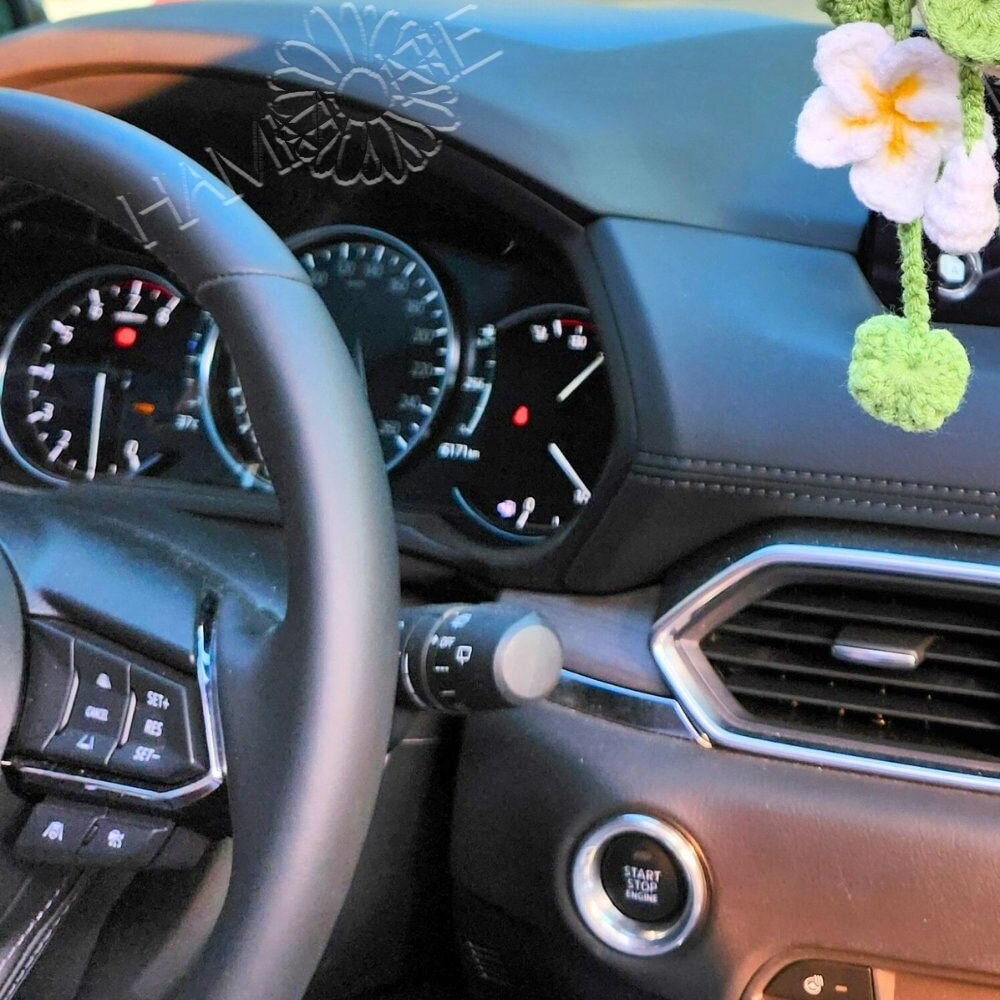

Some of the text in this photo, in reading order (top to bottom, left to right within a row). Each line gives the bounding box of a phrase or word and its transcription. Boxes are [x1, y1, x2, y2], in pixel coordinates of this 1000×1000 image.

[623, 865, 661, 882] START
[627, 878, 658, 892] STOP
[625, 888, 658, 903] ENGINE
